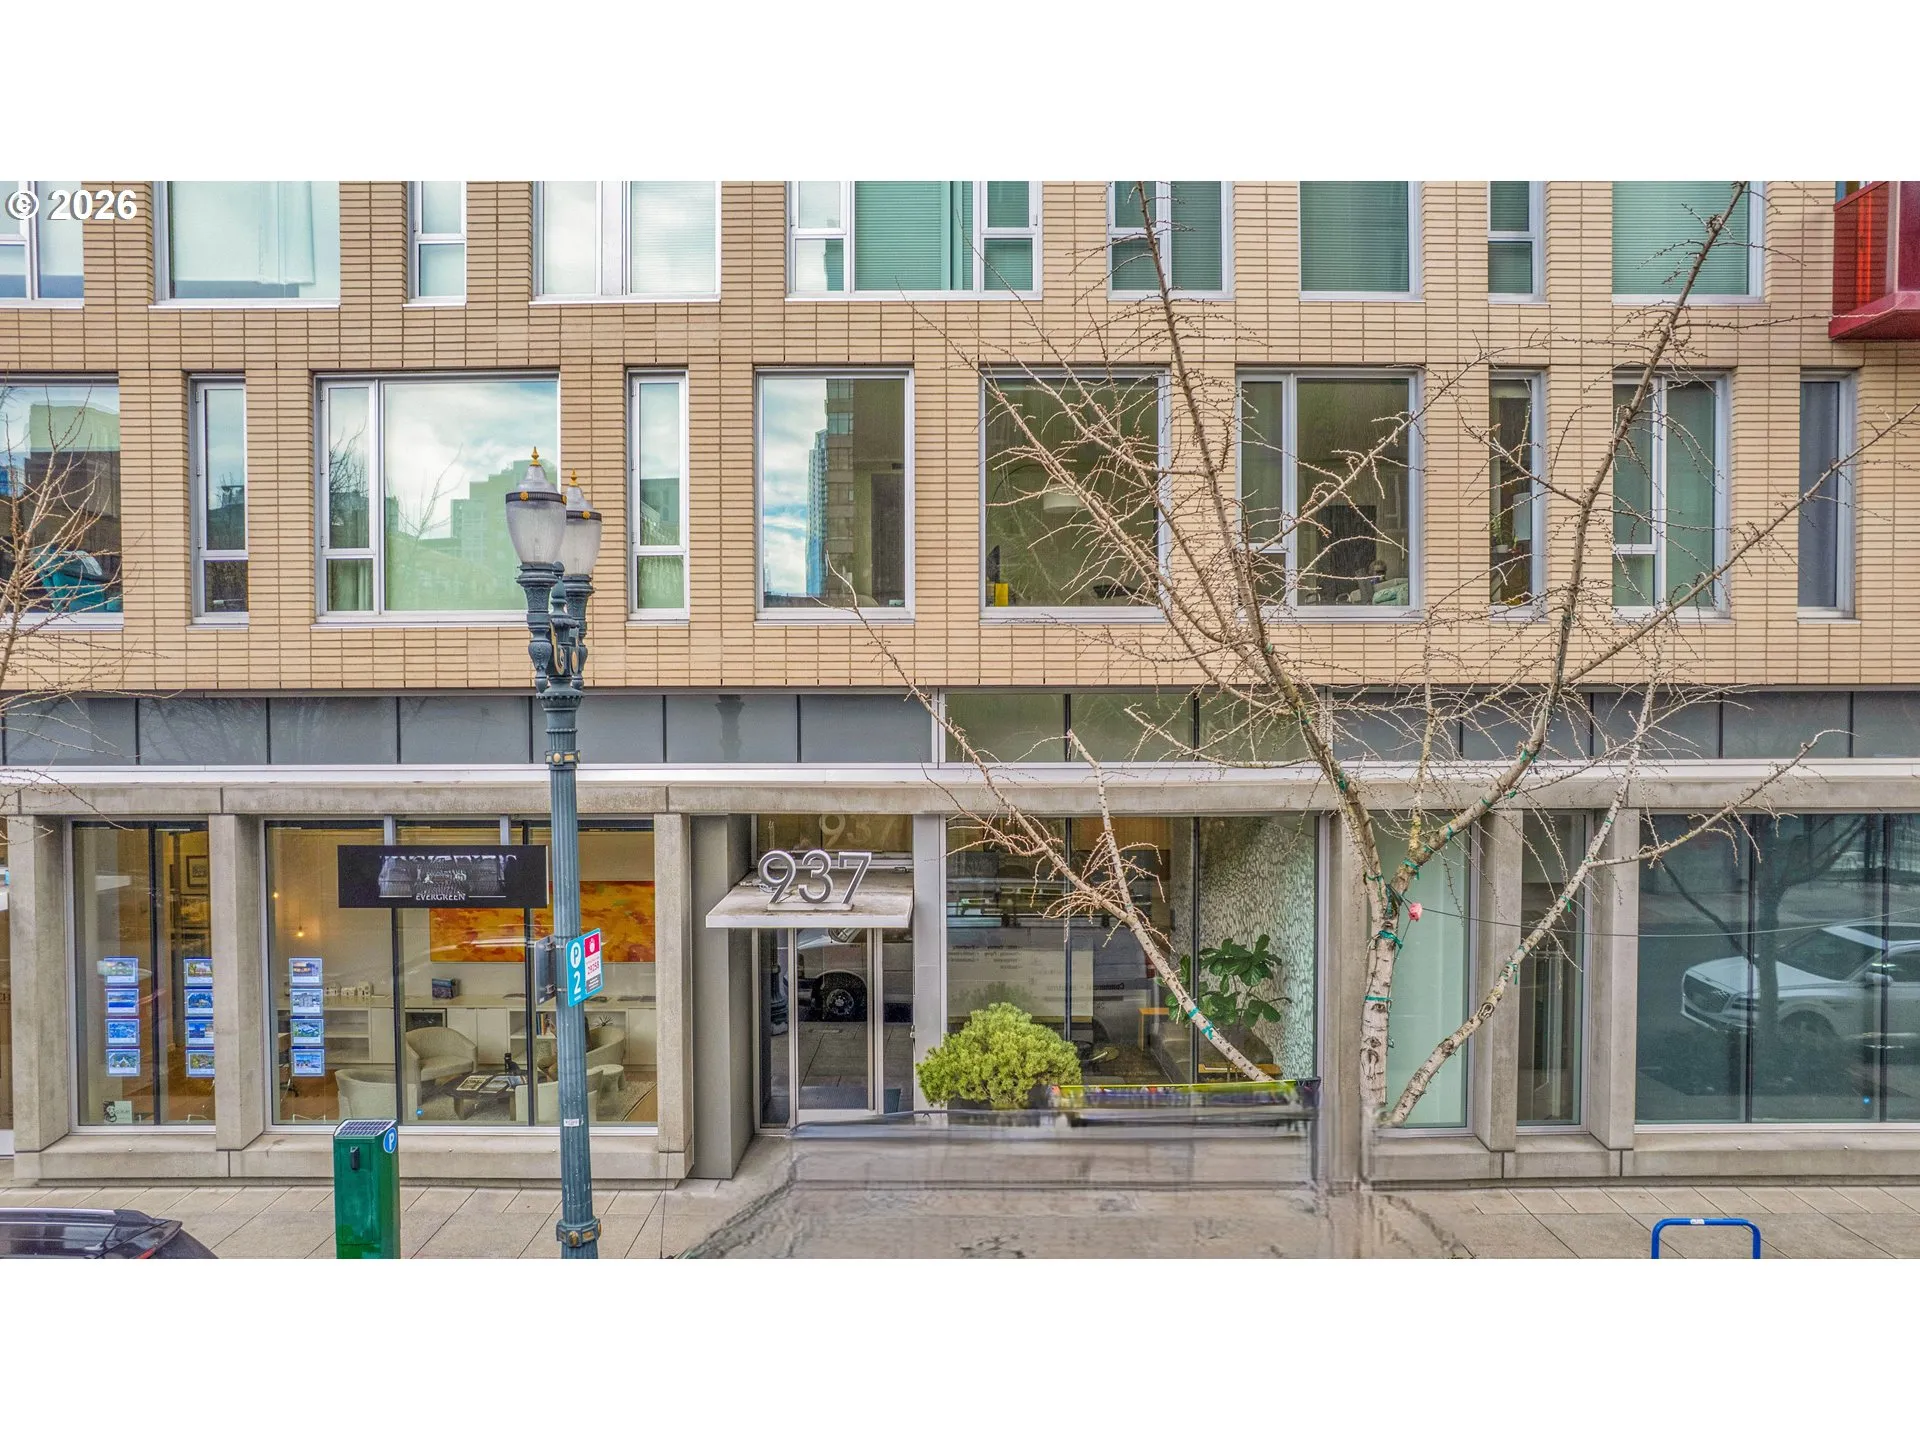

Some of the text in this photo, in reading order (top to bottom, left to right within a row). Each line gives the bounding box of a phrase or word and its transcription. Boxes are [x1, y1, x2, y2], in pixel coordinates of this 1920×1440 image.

[758, 849, 872, 904] 937
[416, 891, 466, 901] EVERGREEN
[573, 970, 582, 995] 2
